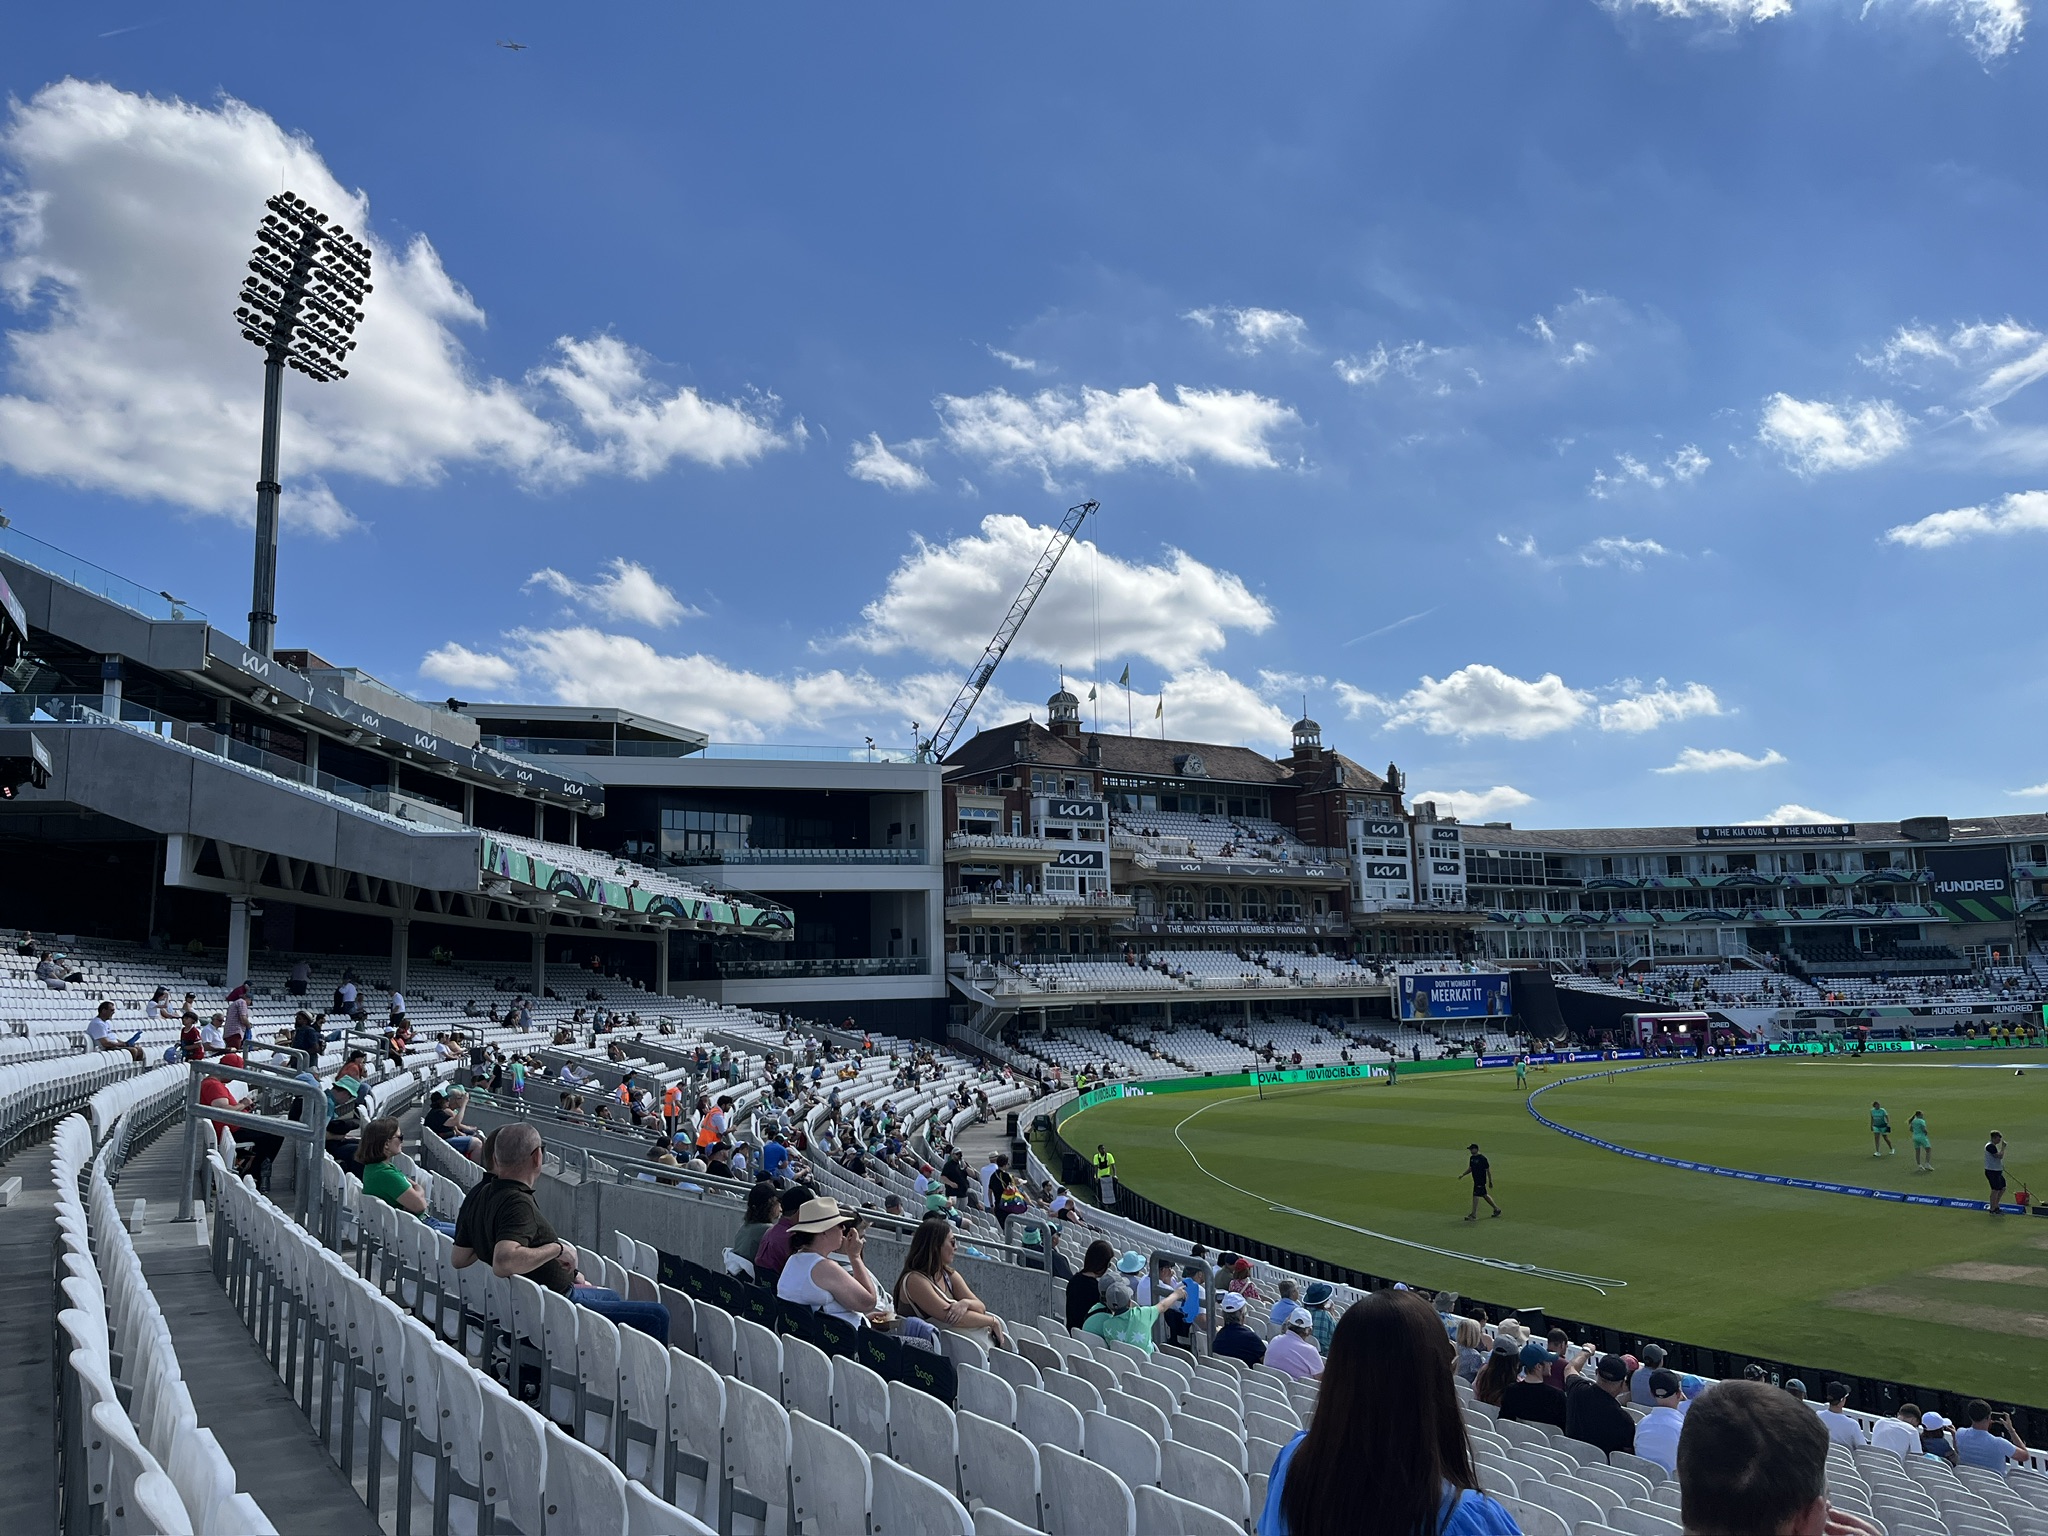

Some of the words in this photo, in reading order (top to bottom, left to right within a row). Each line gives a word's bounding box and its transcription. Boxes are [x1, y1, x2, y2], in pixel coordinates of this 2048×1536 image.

[242, 652, 269, 677] KIA
[362, 713, 379, 728] KIA
[415, 733, 437, 751] KIA
[517, 769, 532, 781] KIA
[564, 782, 583, 796] KIA
[1059, 804, 1094, 817] KIA
[1371, 824, 1398, 834] KIA
[1715, 828, 1730, 837] THE
[1732, 828, 1746, 837] KIA
[1748, 827, 1767, 836] OVAL
[1785, 827, 1800, 835] THE
[1802, 826, 1816, 835] KIA
[1817, 826, 1837, 834] OVAL
[1059, 853, 1094, 865] KIA
[1373, 866, 1400, 876] KIA
[1934, 879, 2004, 892] HUNDRED
[1166, 925, 1182, 933] THE
[1183, 925, 1206, 934] MICKY
[1207, 925, 1239, 934] STEWART
[1240, 925, 1275, 934] MEMBERS'
[1276, 926, 1307, 935] PAVILION
[1407, 980, 1412, 989] 9
[1434, 980, 1450, 988] DON'T
[1450, 980, 1471, 988] WOMBAT
[1472, 979, 1477, 987] IT
[1431, 988, 1472, 1002] MEERKAT
[1474, 988, 1482, 1001] IT
[1931, 1007, 1973, 1016] HUNDRED
[1992, 1004, 2033, 1013] HUNDRED
[1258, 1072, 1284, 1084] OVAL
[823, 1324, 840, 1344] Sage
[867, 1341, 886, 1362] Sage
[914, 1364, 934, 1386] Sage
